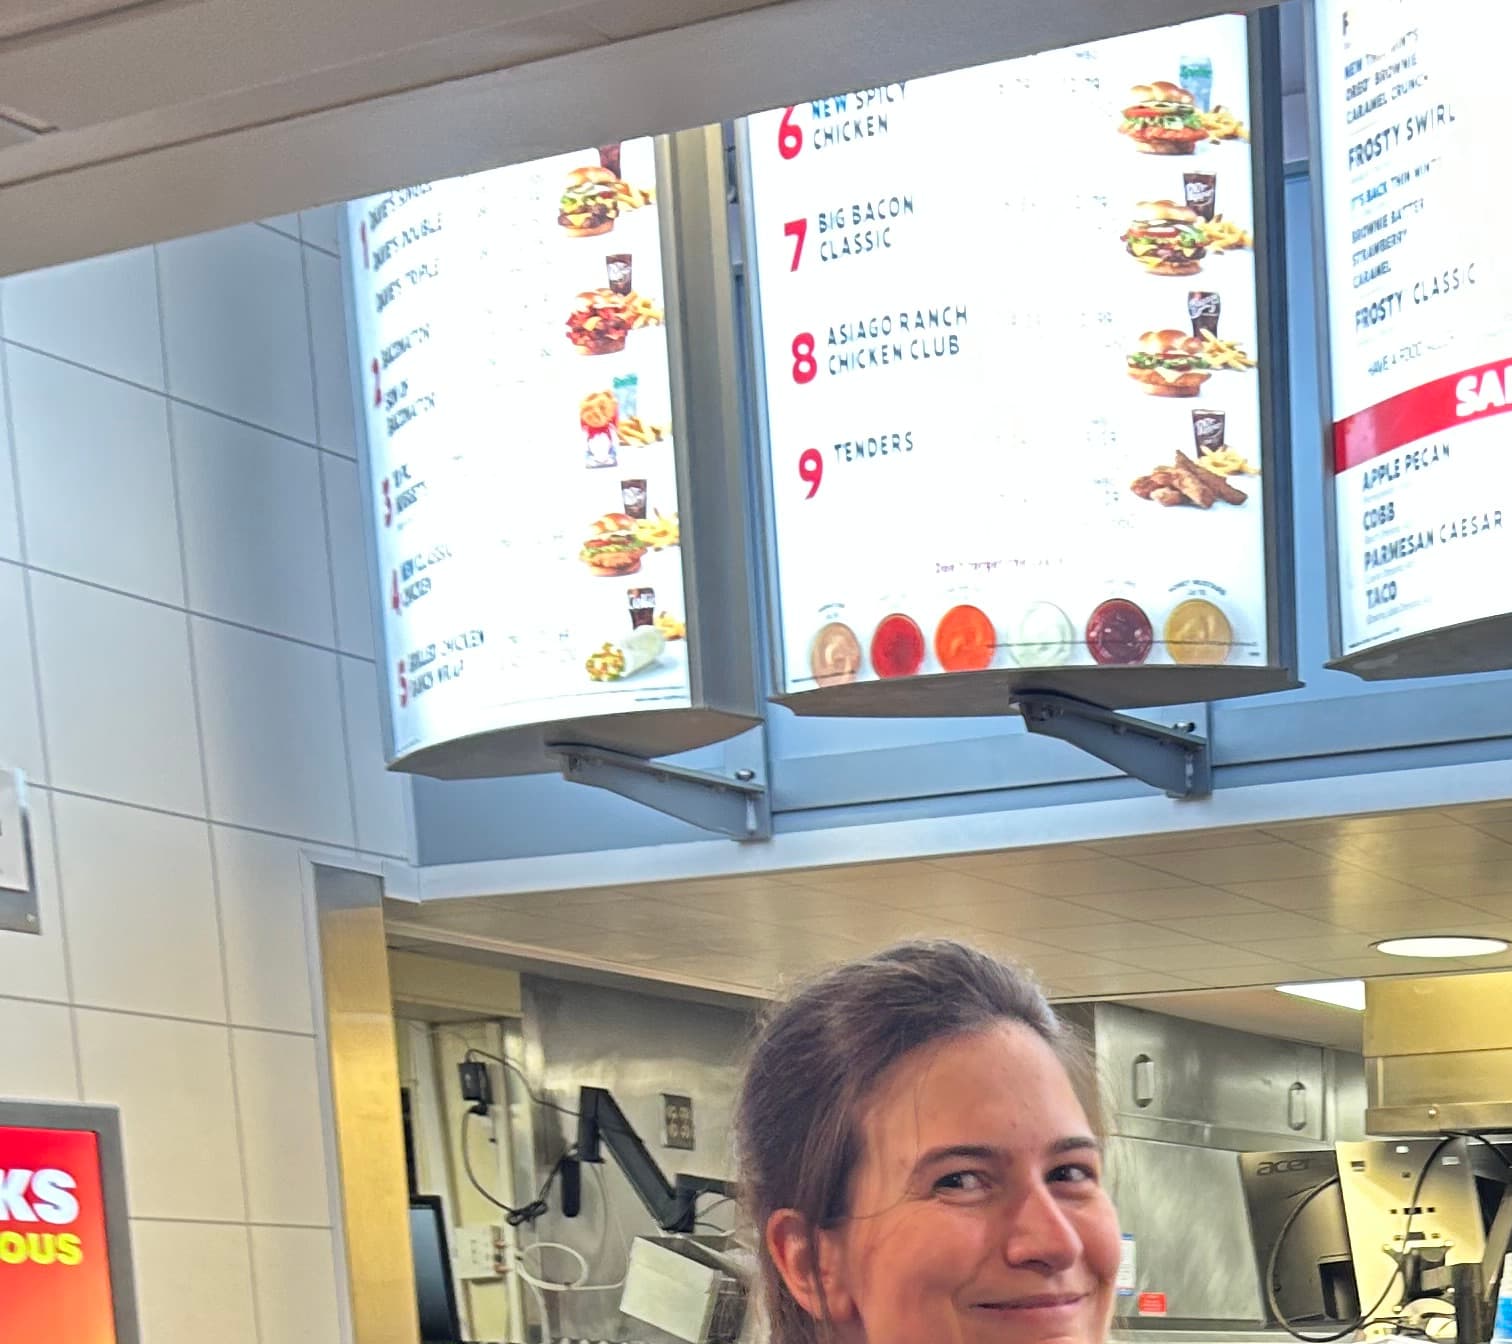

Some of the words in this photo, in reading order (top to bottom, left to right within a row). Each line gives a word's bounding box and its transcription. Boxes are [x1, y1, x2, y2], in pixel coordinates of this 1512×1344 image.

[778, 105, 803, 160] 6
[811, 95, 847, 120] NEW
[813, 114, 889, 150] CHICKEN
[1348, 123, 1401, 171] FROSTY
[1406, 103, 1456, 142] SWIRL
[784, 218, 808, 272] 7
[818, 207, 846, 234] BIG
[852, 195, 914, 226] BACON
[820, 226, 892, 262] CLASSIC
[1355, 290, 1403, 334] FROSTY
[1413, 262, 1476, 305] CLASSIC
[791, 332, 818, 385] 8
[828, 315, 892, 347] ASIAGO
[900, 304, 968, 333] RANCH
[828, 343, 902, 376] CHICKEN
[910, 334, 960, 361] CLUB
[798, 447, 824, 501] 9
[833, 431, 914, 465] TENDERS
[1362, 458, 1401, 492] APPLE
[1405, 442, 1451, 473] PECAN
[1362, 501, 1396, 531] COBB
[1364, 528, 1435, 573] PARMESAN
[1440, 510, 1504, 544] CAESAR
[1366, 580, 1398, 609] TACO
[1257, 1159, 1318, 1176] acer
